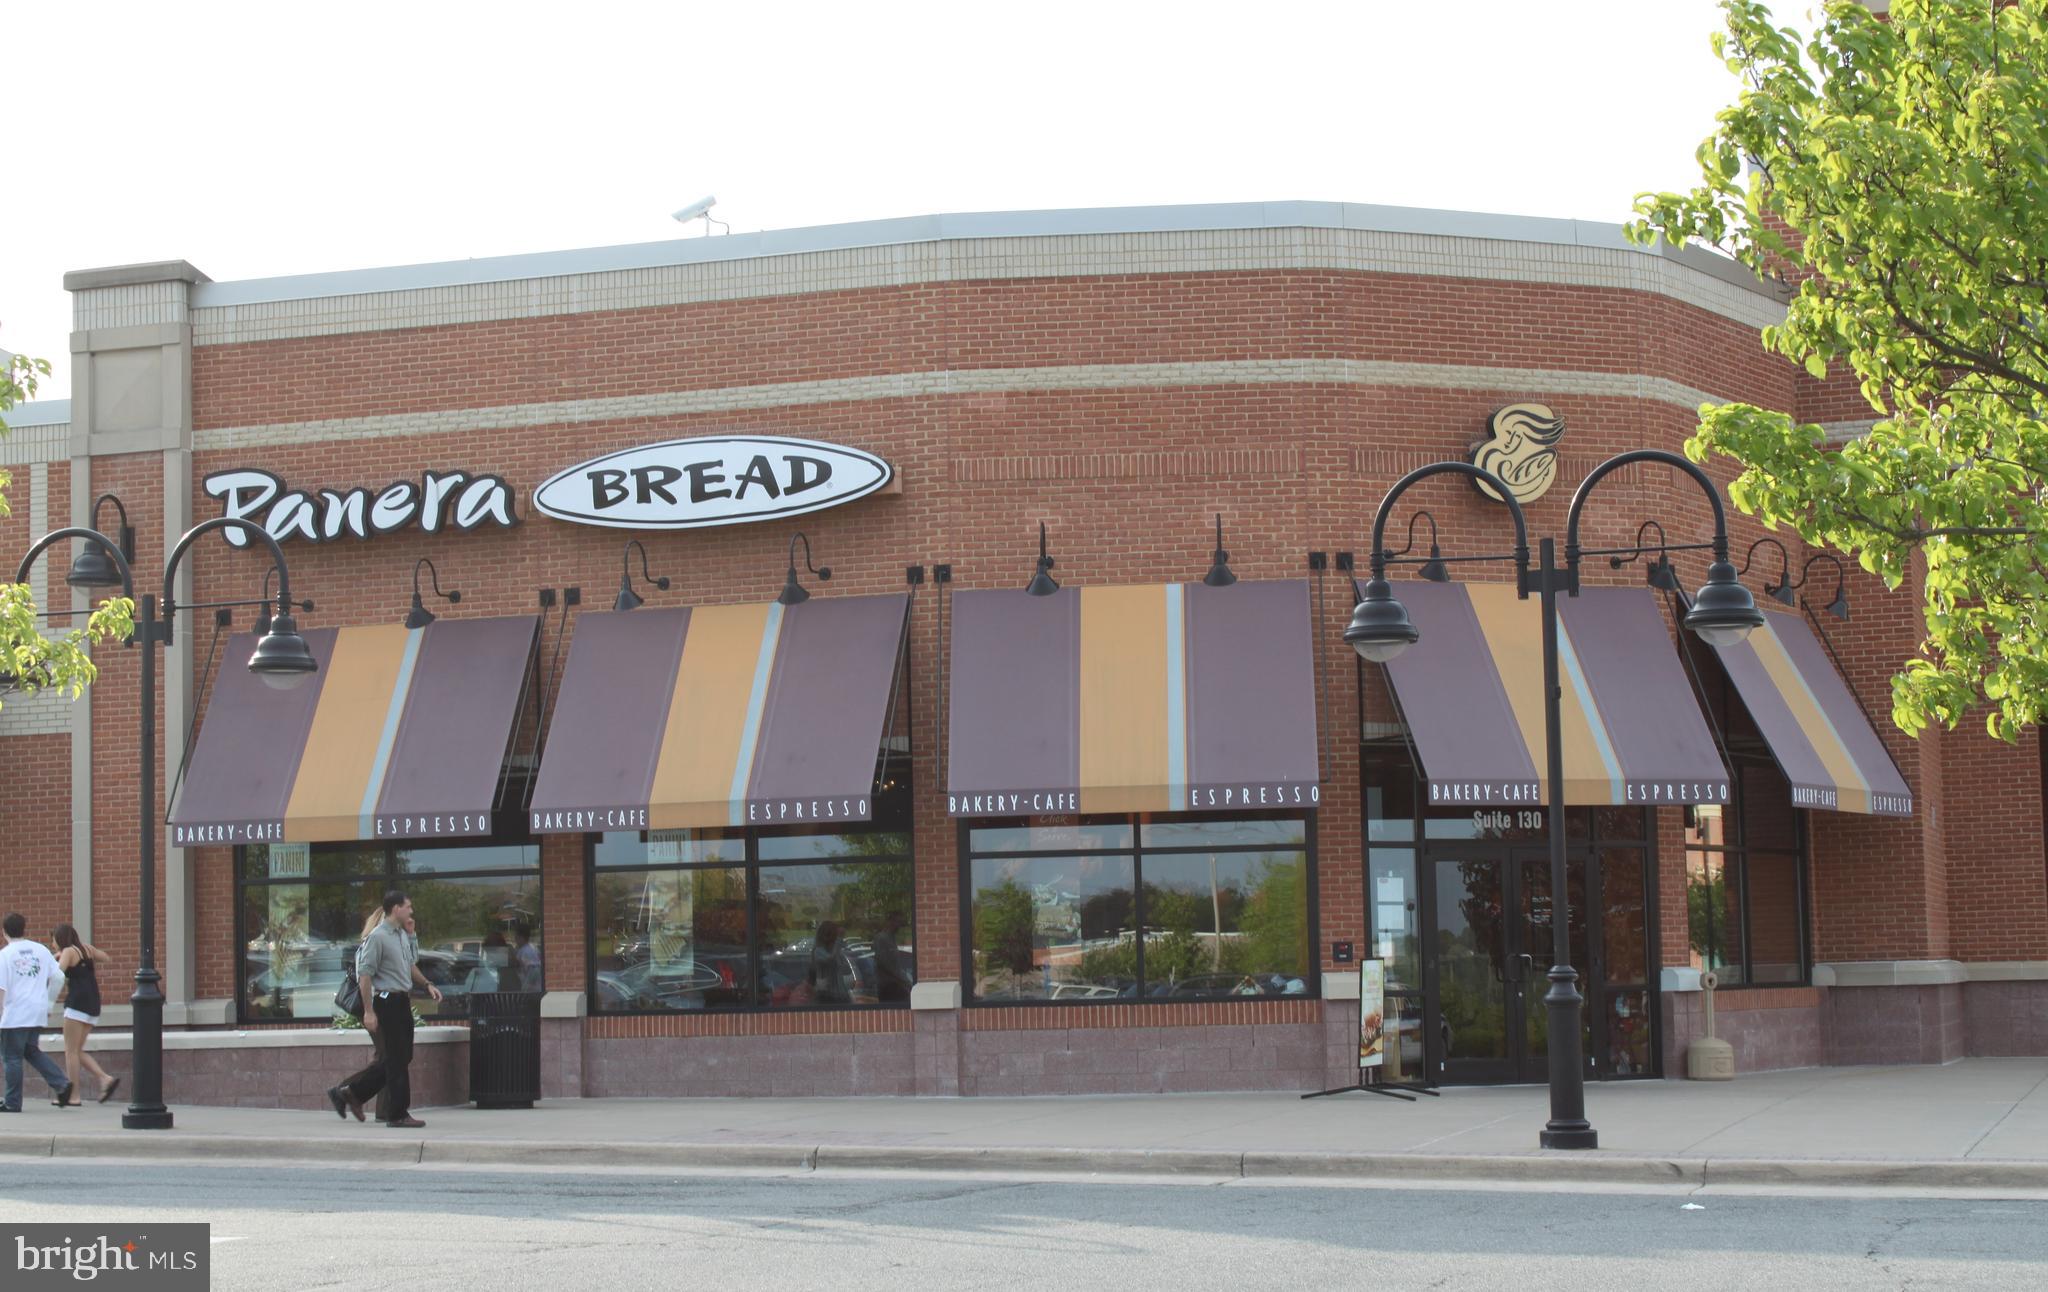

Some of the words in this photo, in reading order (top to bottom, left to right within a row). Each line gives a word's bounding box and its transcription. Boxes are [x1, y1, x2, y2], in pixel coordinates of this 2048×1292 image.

[203, 469, 514, 548] Panera
[587, 455, 832, 510] BREAD
[948, 793, 1075, 813] BAKERY-CAFE
[1192, 785, 1320, 806] ESPRESSO
[1432, 784, 1539, 801] BAKERY-CAFE
[1627, 784, 1729, 800] ESPRESSO
[1793, 787, 1836, 807] BAKERY-CAFE
[1873, 795, 1912, 813] ESPRESSO
[534, 809, 645, 829] BAKERY-CAFE
[750, 799, 867, 820] ESPRESSO
[1473, 810, 1511, 829] Suite
[1517, 811, 1542, 829] 130
[177, 823, 282, 842] BAKERY-CAFE
[377, 815, 487, 835] ESPRESSO
[274, 851, 305, 873] PANINI
